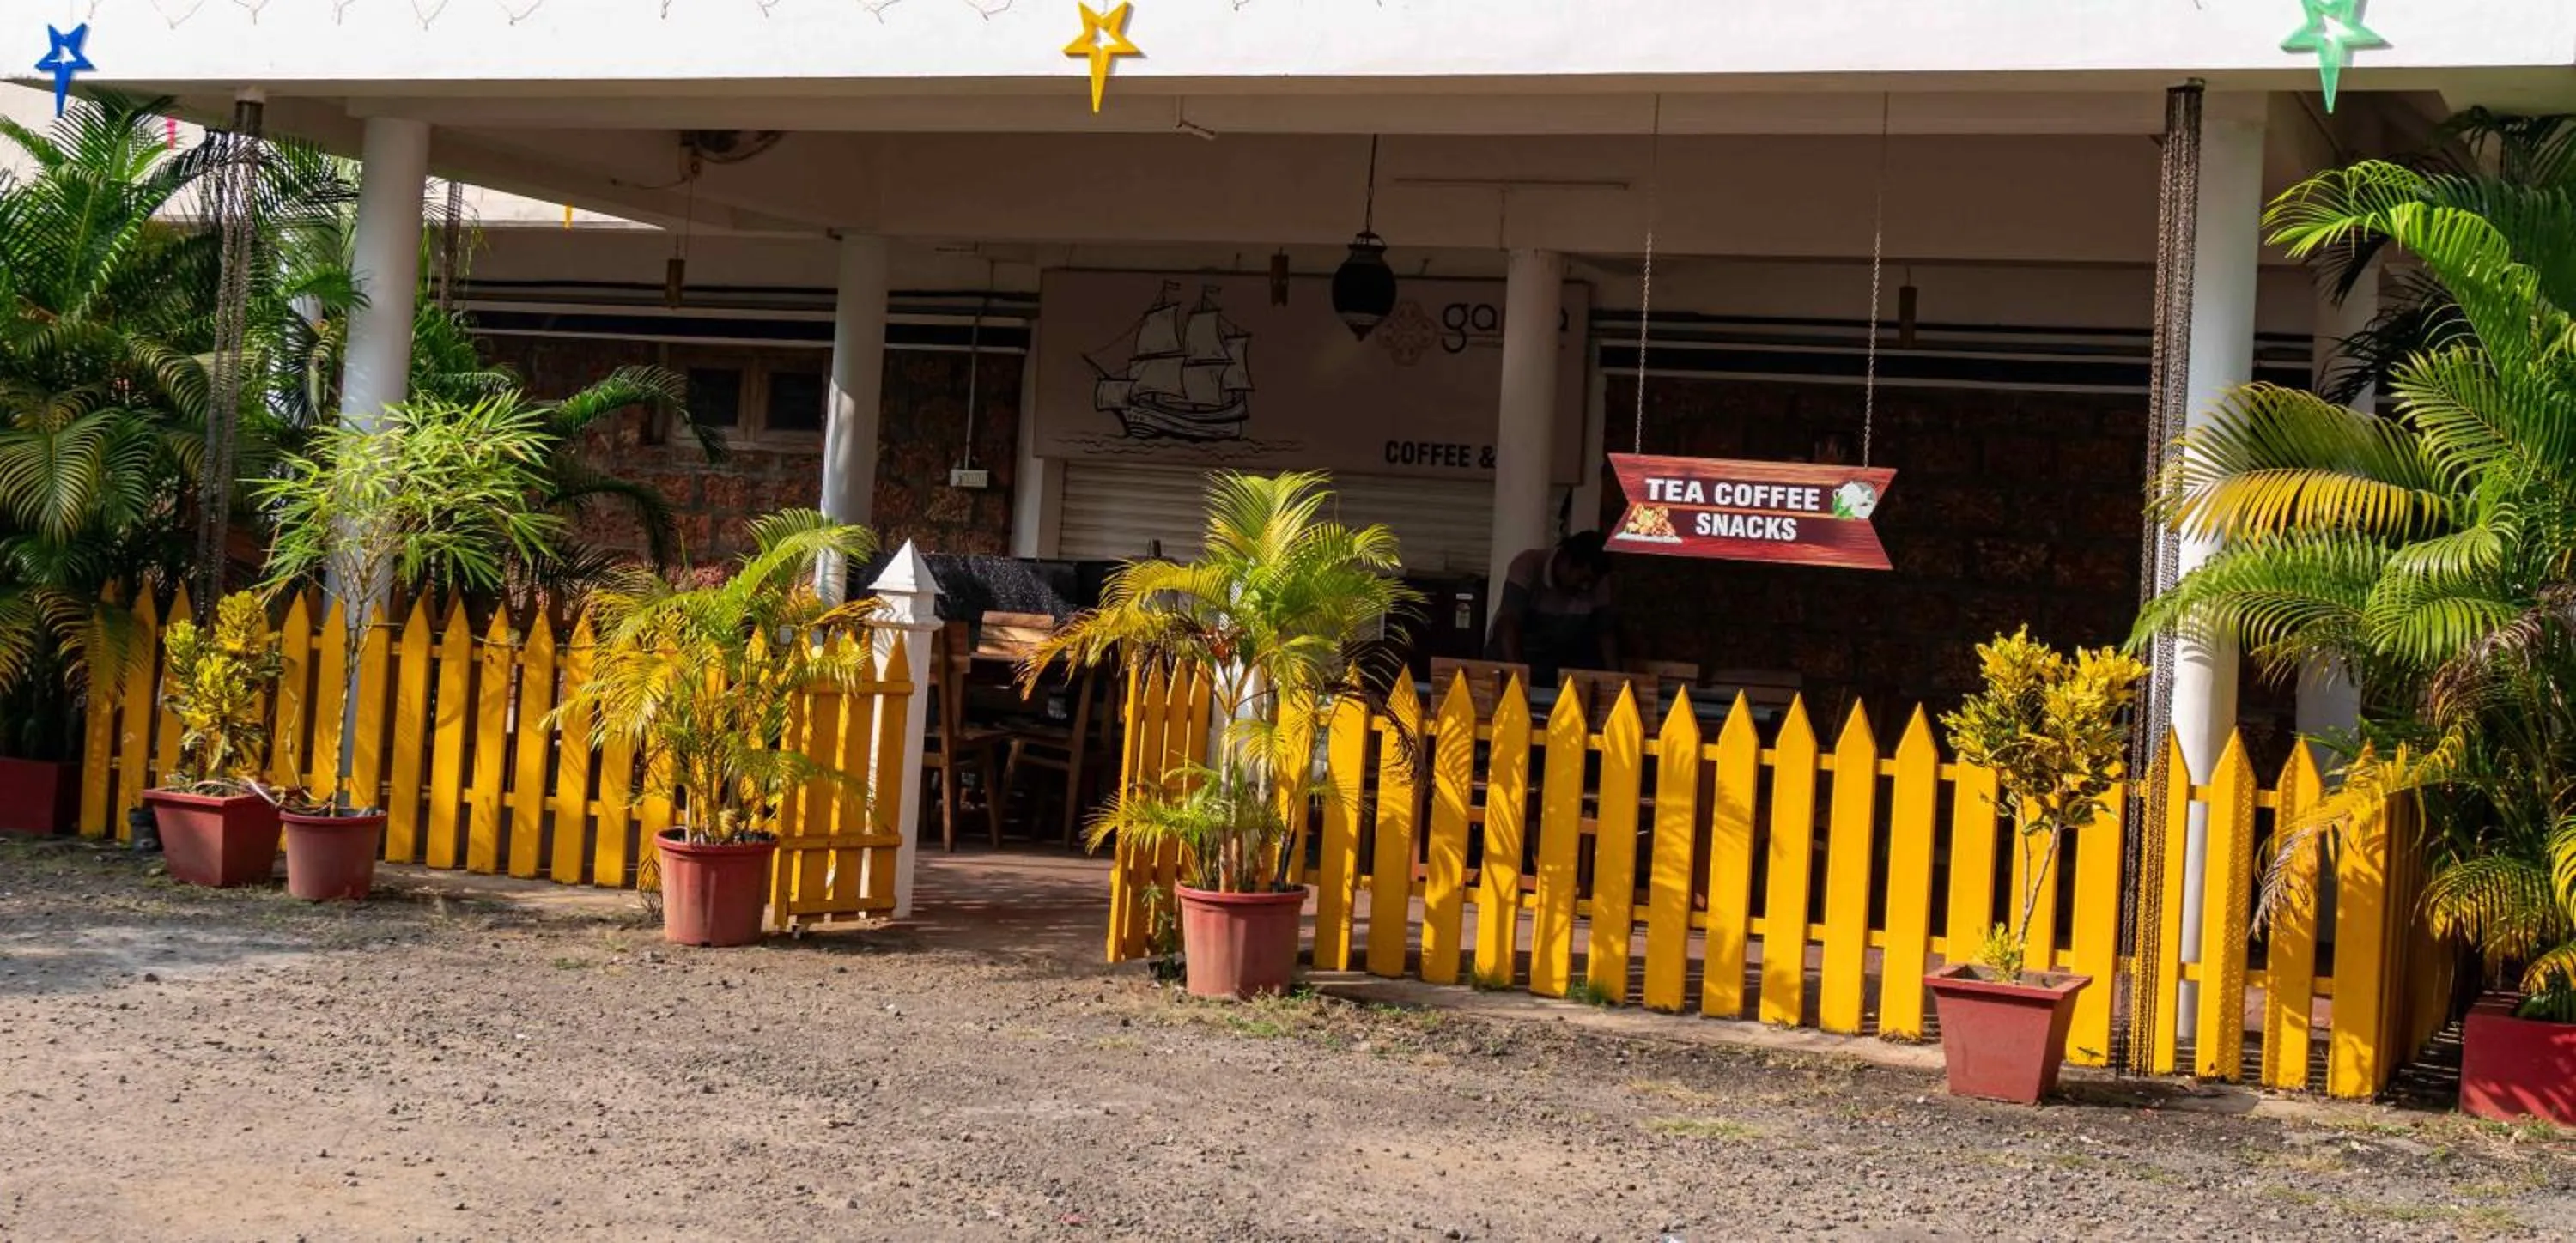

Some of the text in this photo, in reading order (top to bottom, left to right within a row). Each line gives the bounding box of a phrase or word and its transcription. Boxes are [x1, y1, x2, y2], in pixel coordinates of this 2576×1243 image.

[1385, 440, 1497, 469] COFFEE &
[1645, 478, 1820, 511] TEA COFFEE
[1695, 512, 1798, 541] SNACKS
